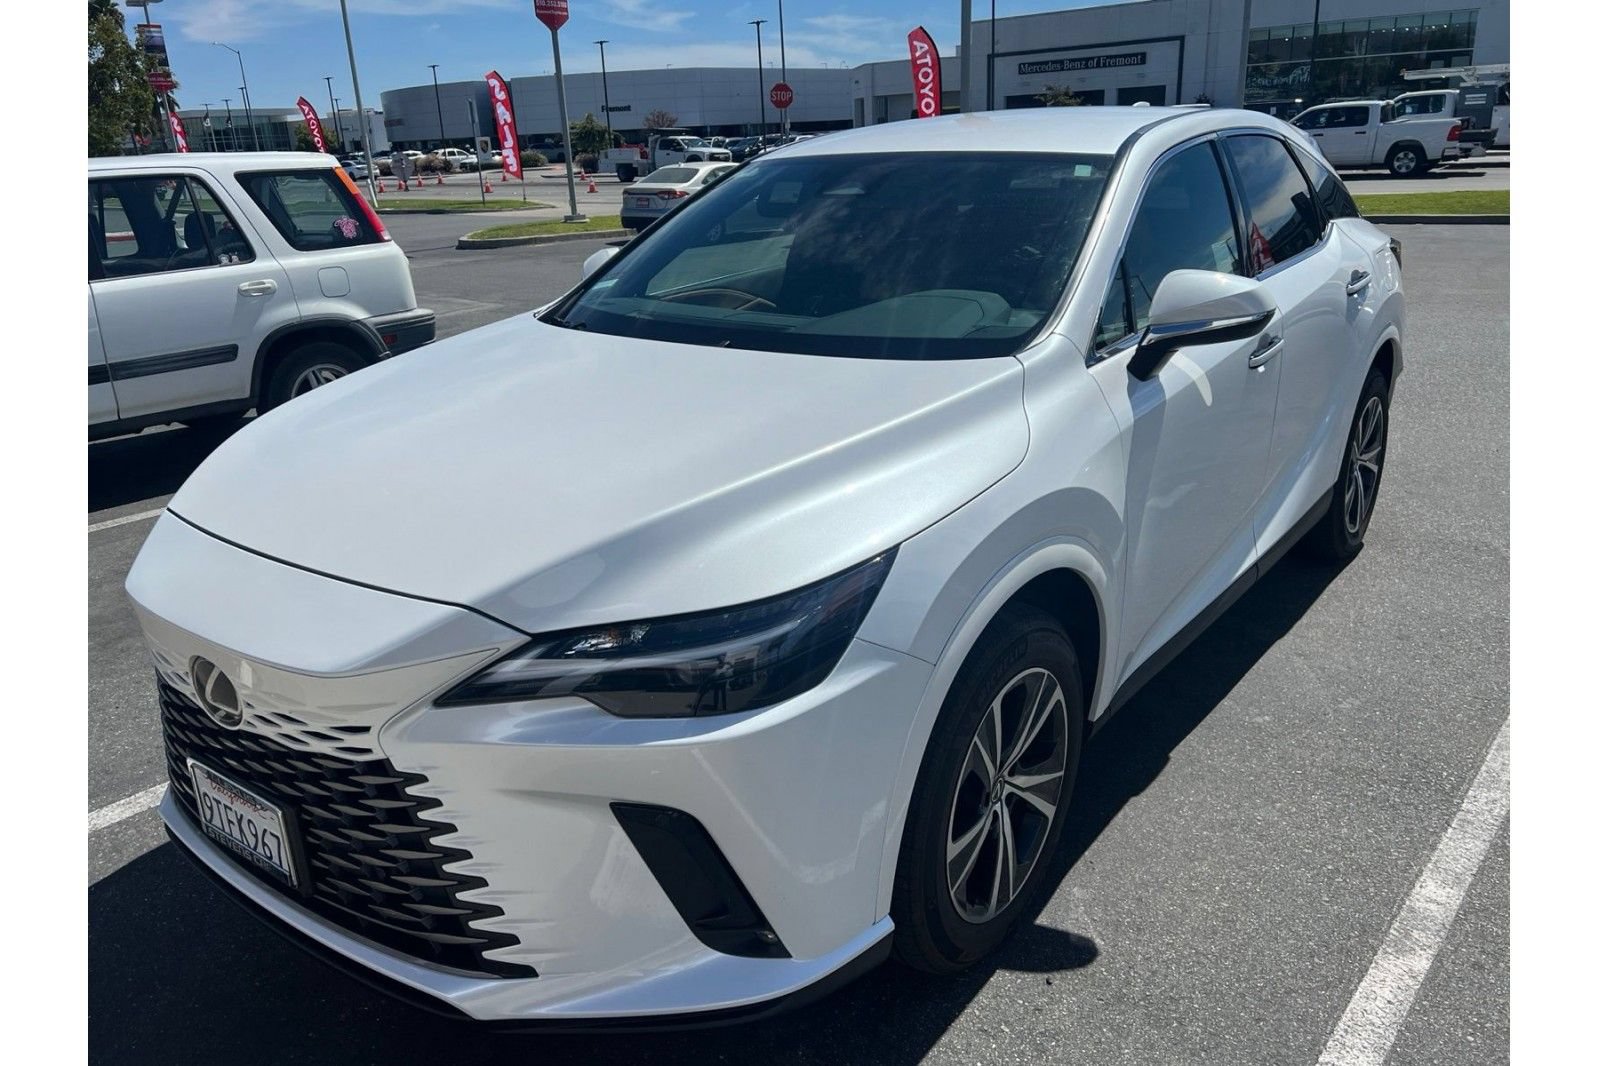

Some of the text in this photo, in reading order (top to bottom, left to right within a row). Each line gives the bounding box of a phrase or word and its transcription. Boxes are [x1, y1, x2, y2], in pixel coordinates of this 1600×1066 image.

[1019, 54, 1142, 74] Mercedes-Benz of Fremont
[771, 91, 792, 101] STOP
[202, 791, 283, 869] 9TFK967
